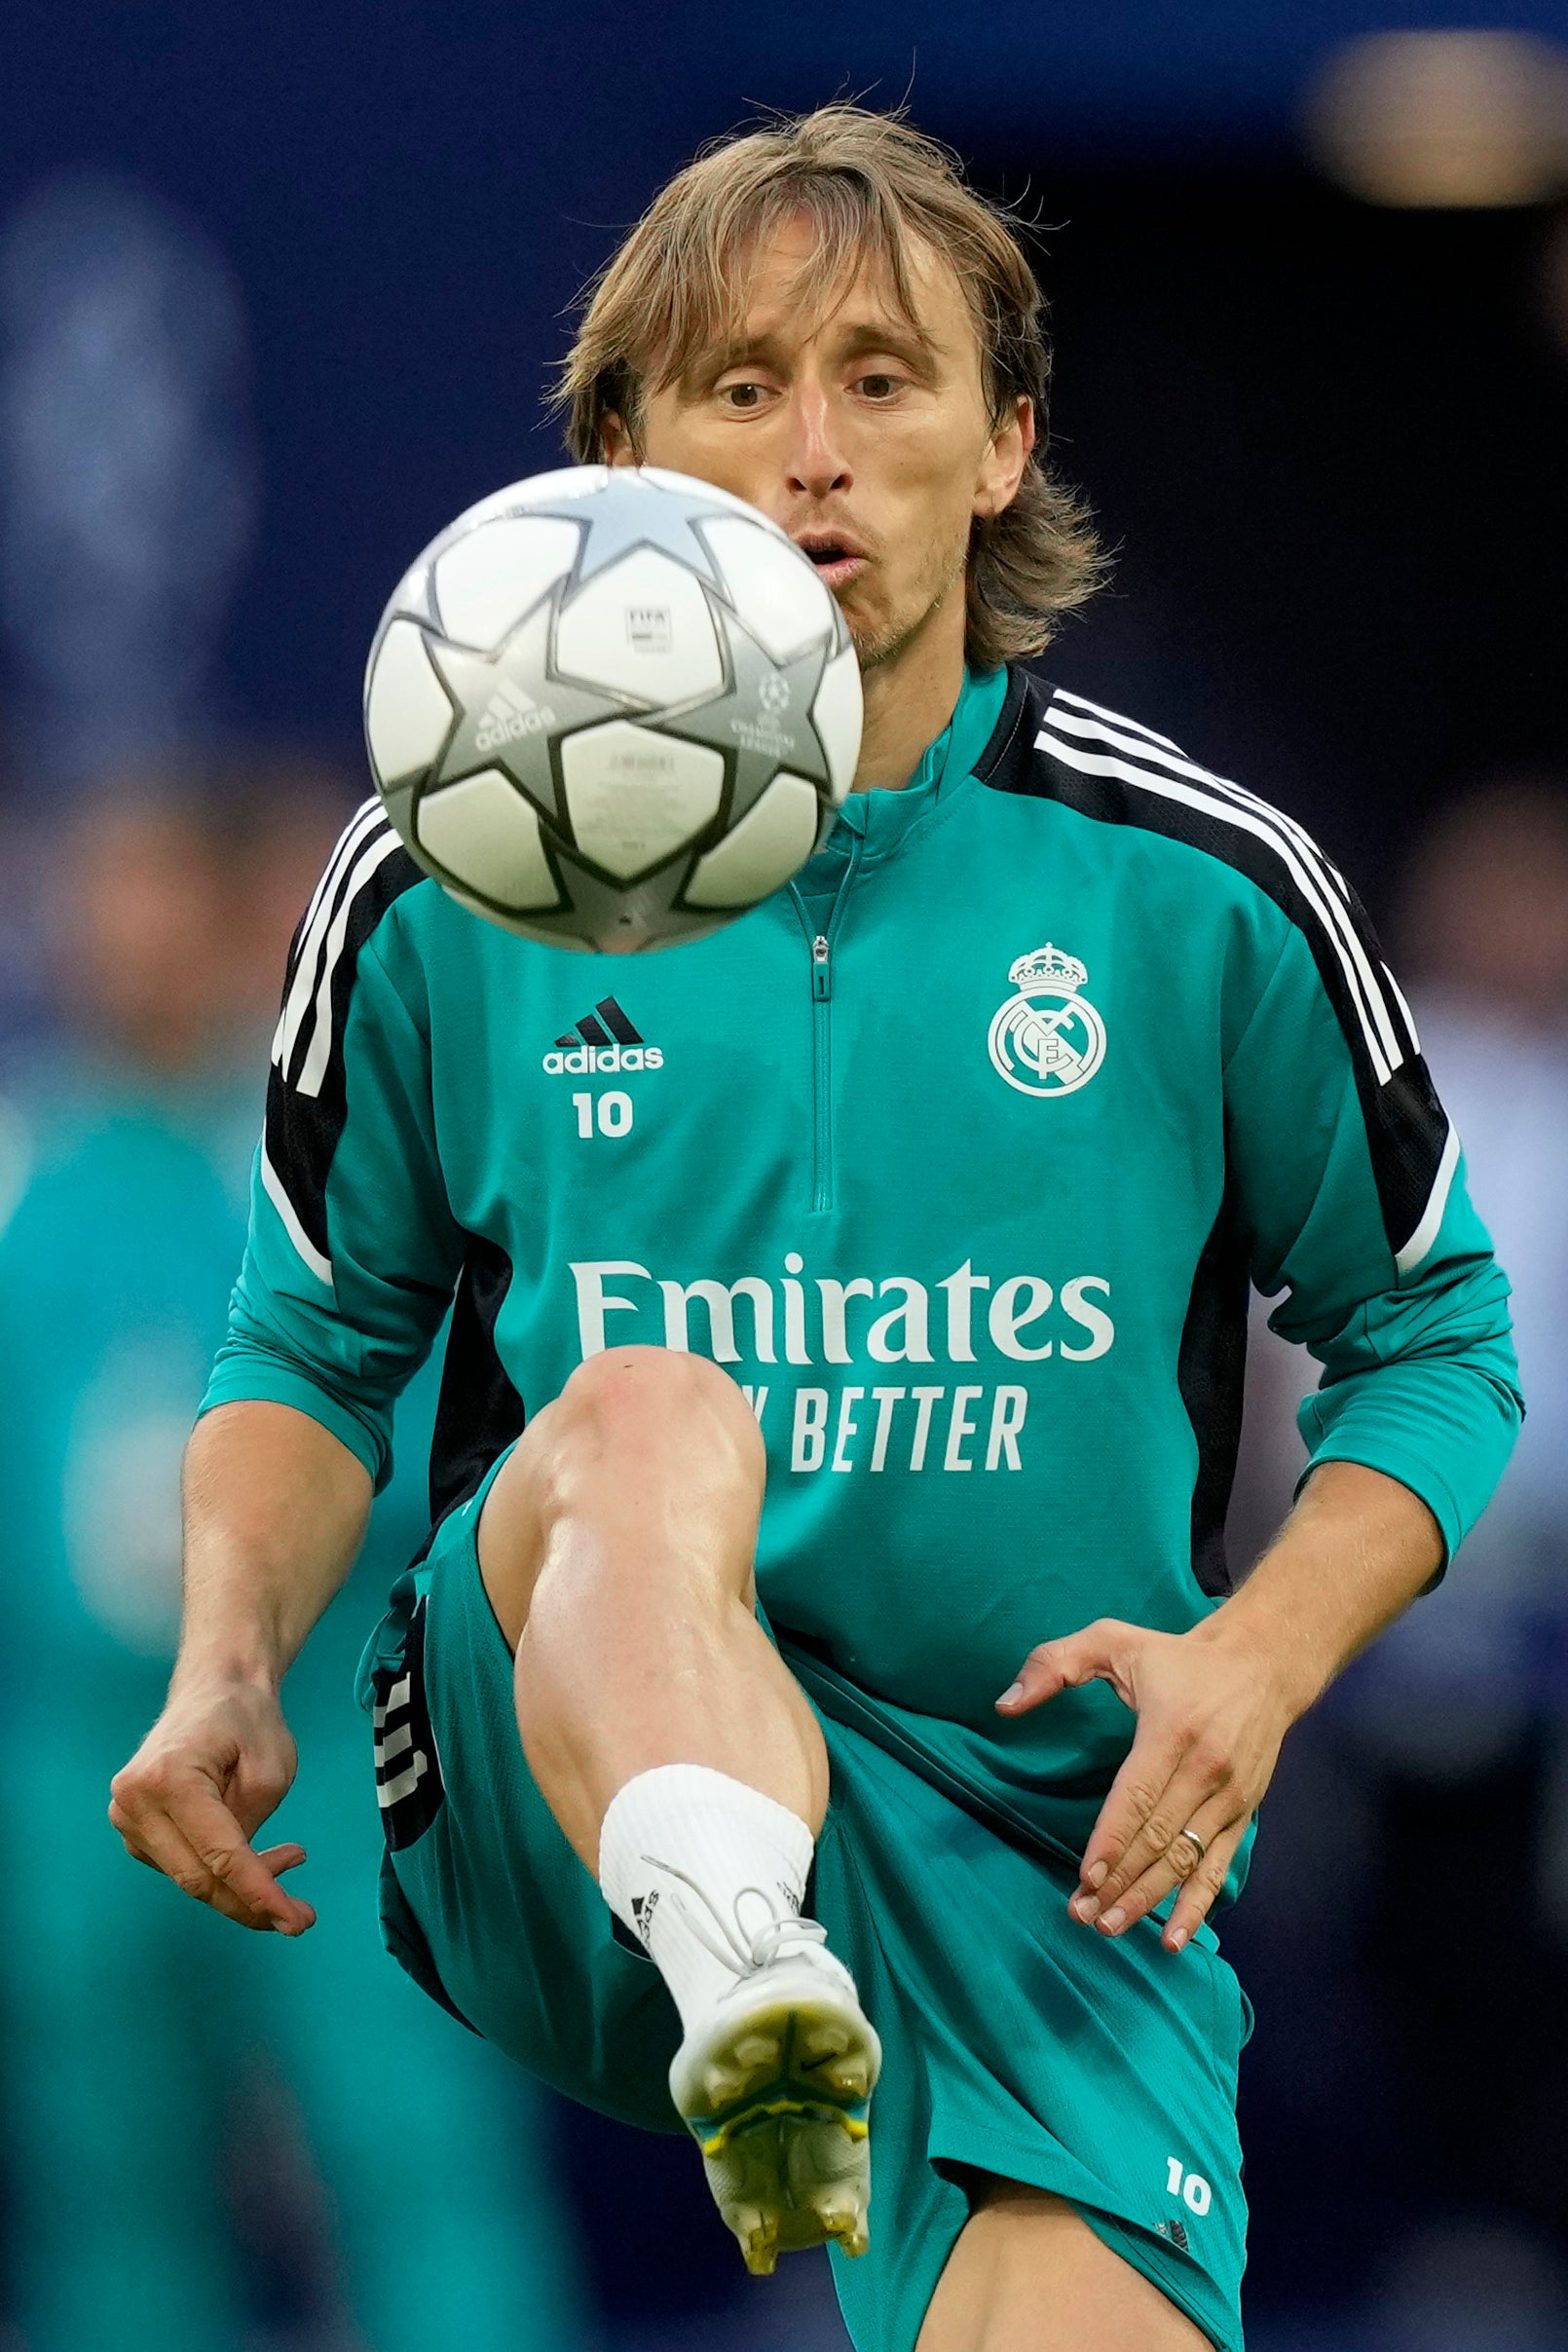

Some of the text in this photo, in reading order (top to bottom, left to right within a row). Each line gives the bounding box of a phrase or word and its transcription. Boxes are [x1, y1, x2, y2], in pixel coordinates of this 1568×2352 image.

[474, 705, 556, 752] adidas
[542, 1043, 664, 1075] adidas
[573, 1090, 633, 1139] 10
[568, 1251, 1116, 1364] Emirates
[791, 1385, 1028, 1473] BETTER
[1166, 2155, 1213, 2217] 10
